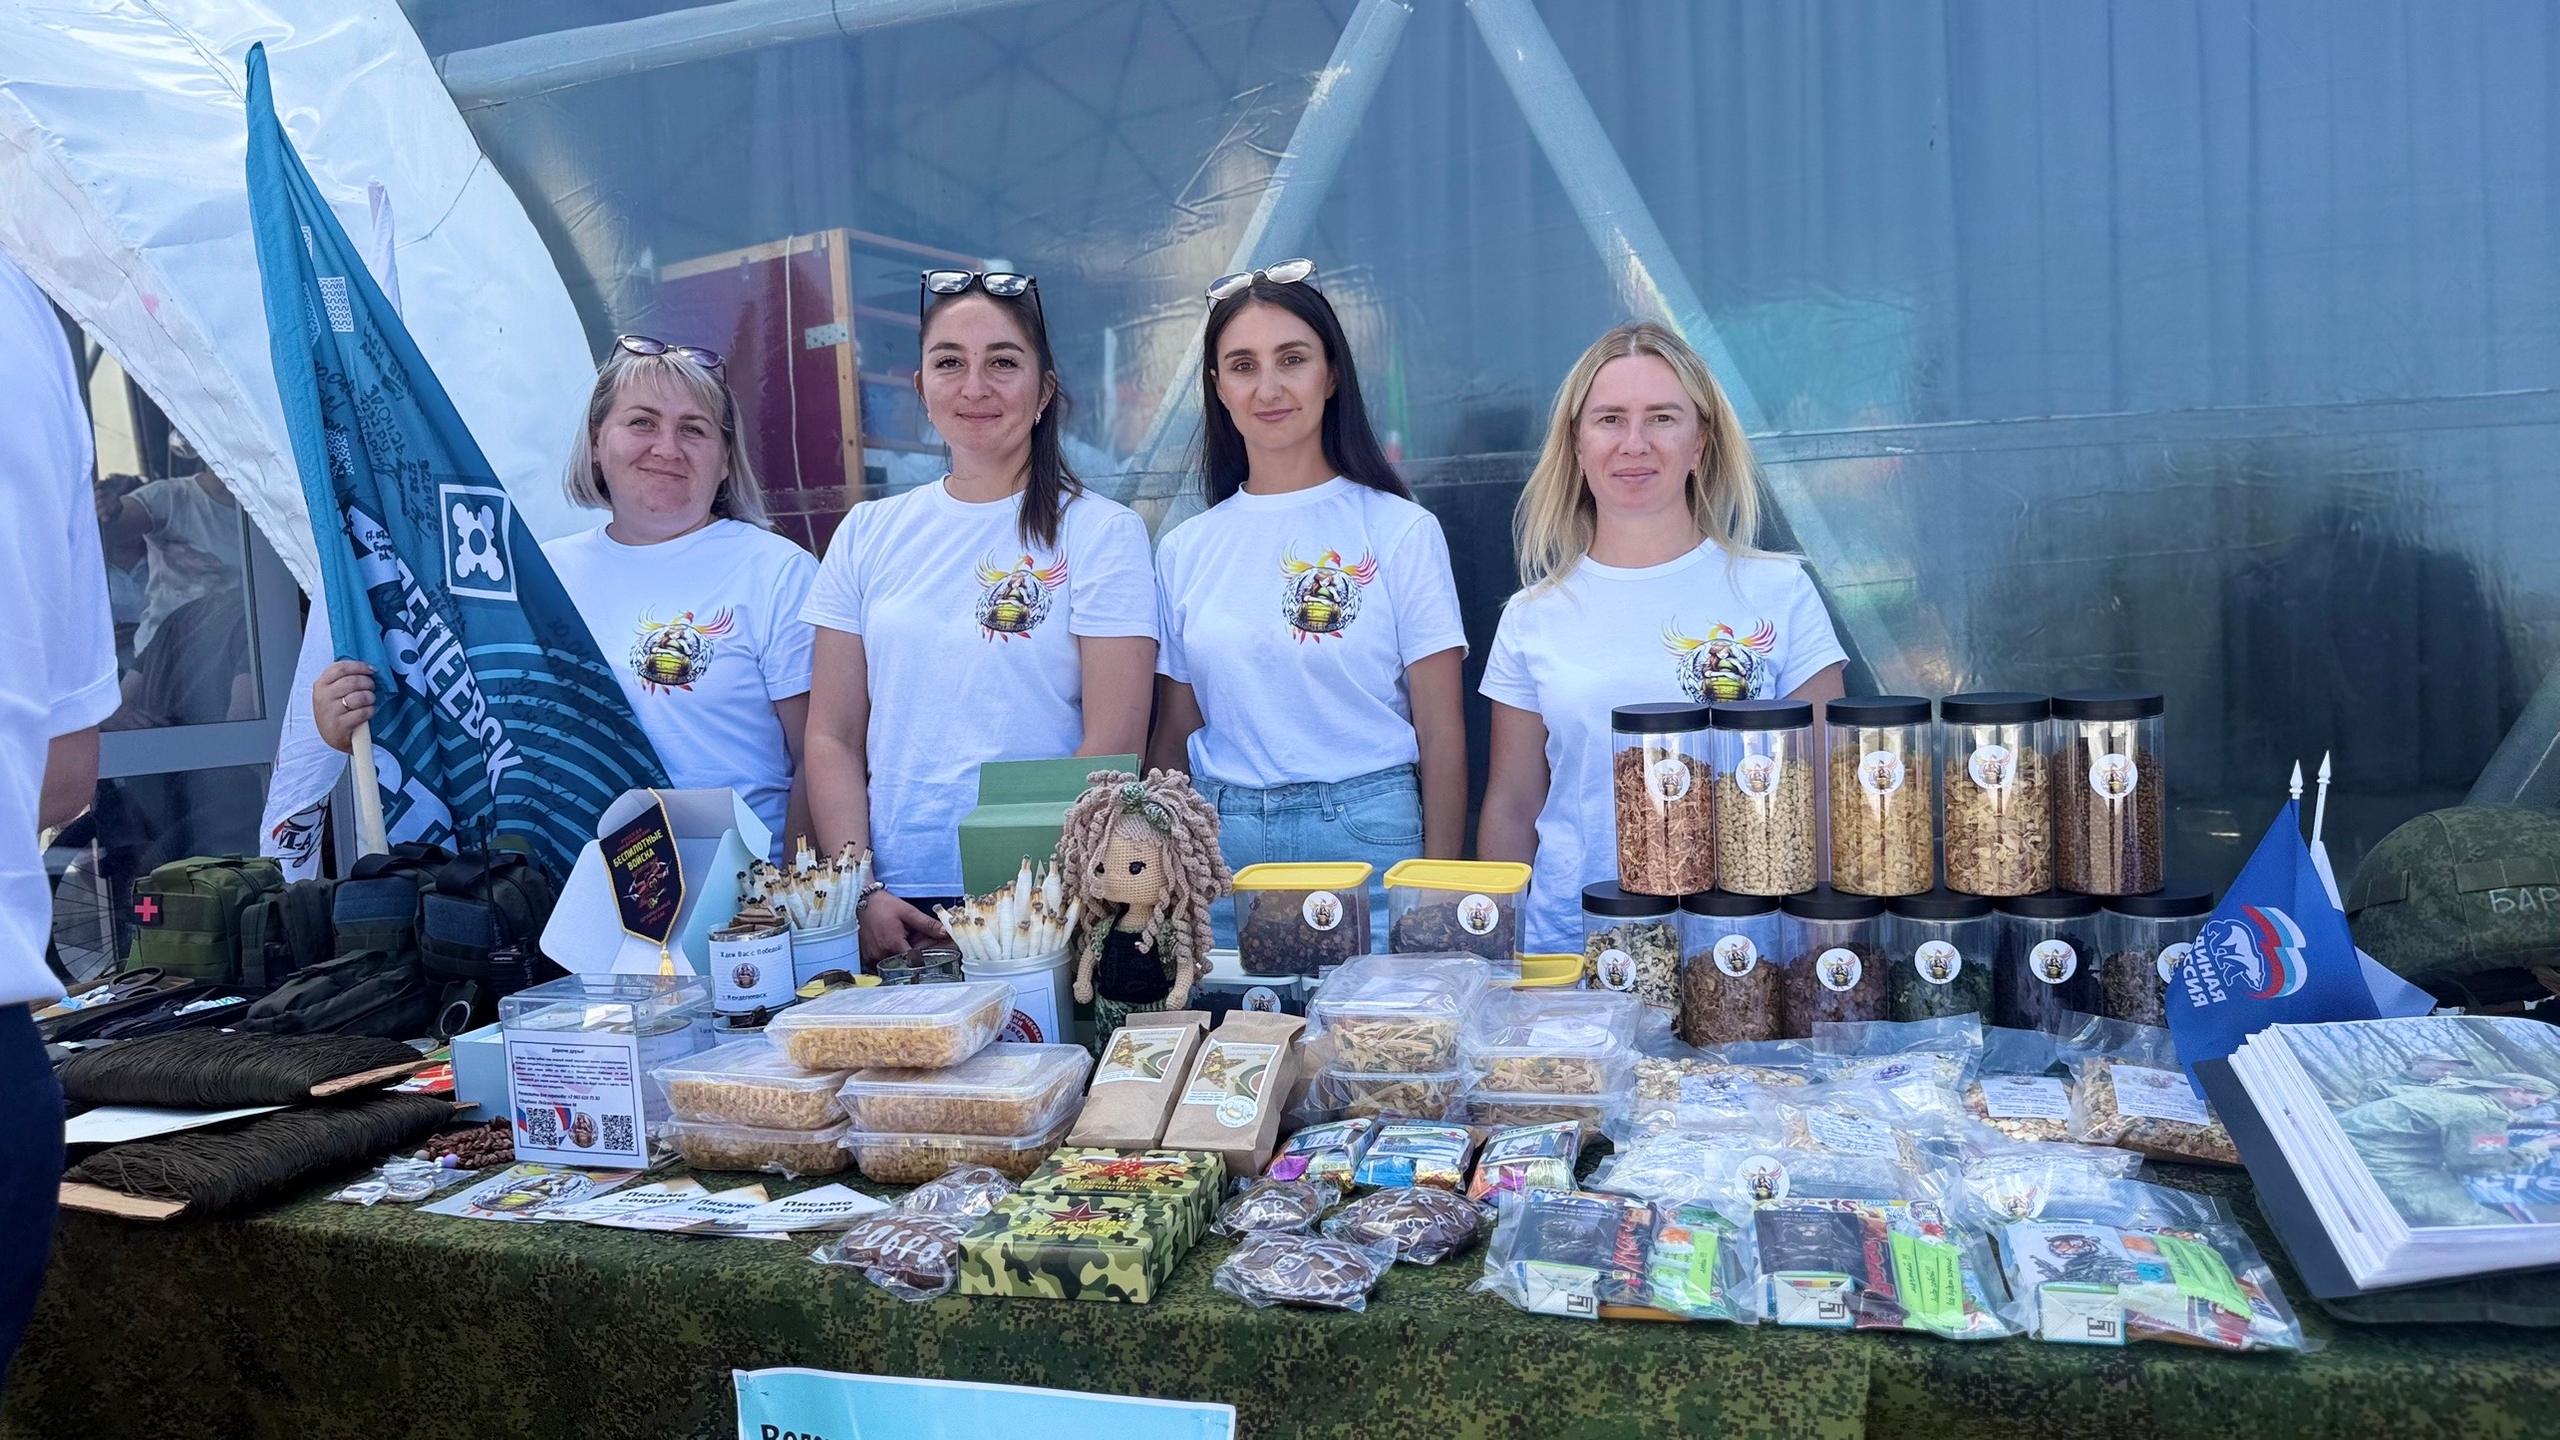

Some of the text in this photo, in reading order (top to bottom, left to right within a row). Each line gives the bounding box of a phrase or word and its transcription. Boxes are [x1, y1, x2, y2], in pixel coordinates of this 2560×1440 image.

[612, 828, 664, 868] БЕСПИЛОТНЫЕ
[626, 847, 656, 872] ВОЙСКА
[2193, 924, 2228, 1004] ДИНАЯ
[2181, 953, 2210, 1009] ССИЯ
[625, 1190, 688, 1199] Письмо
[783, 1200, 853, 1209] Письмо
[779, 1205, 853, 1214] солдату
